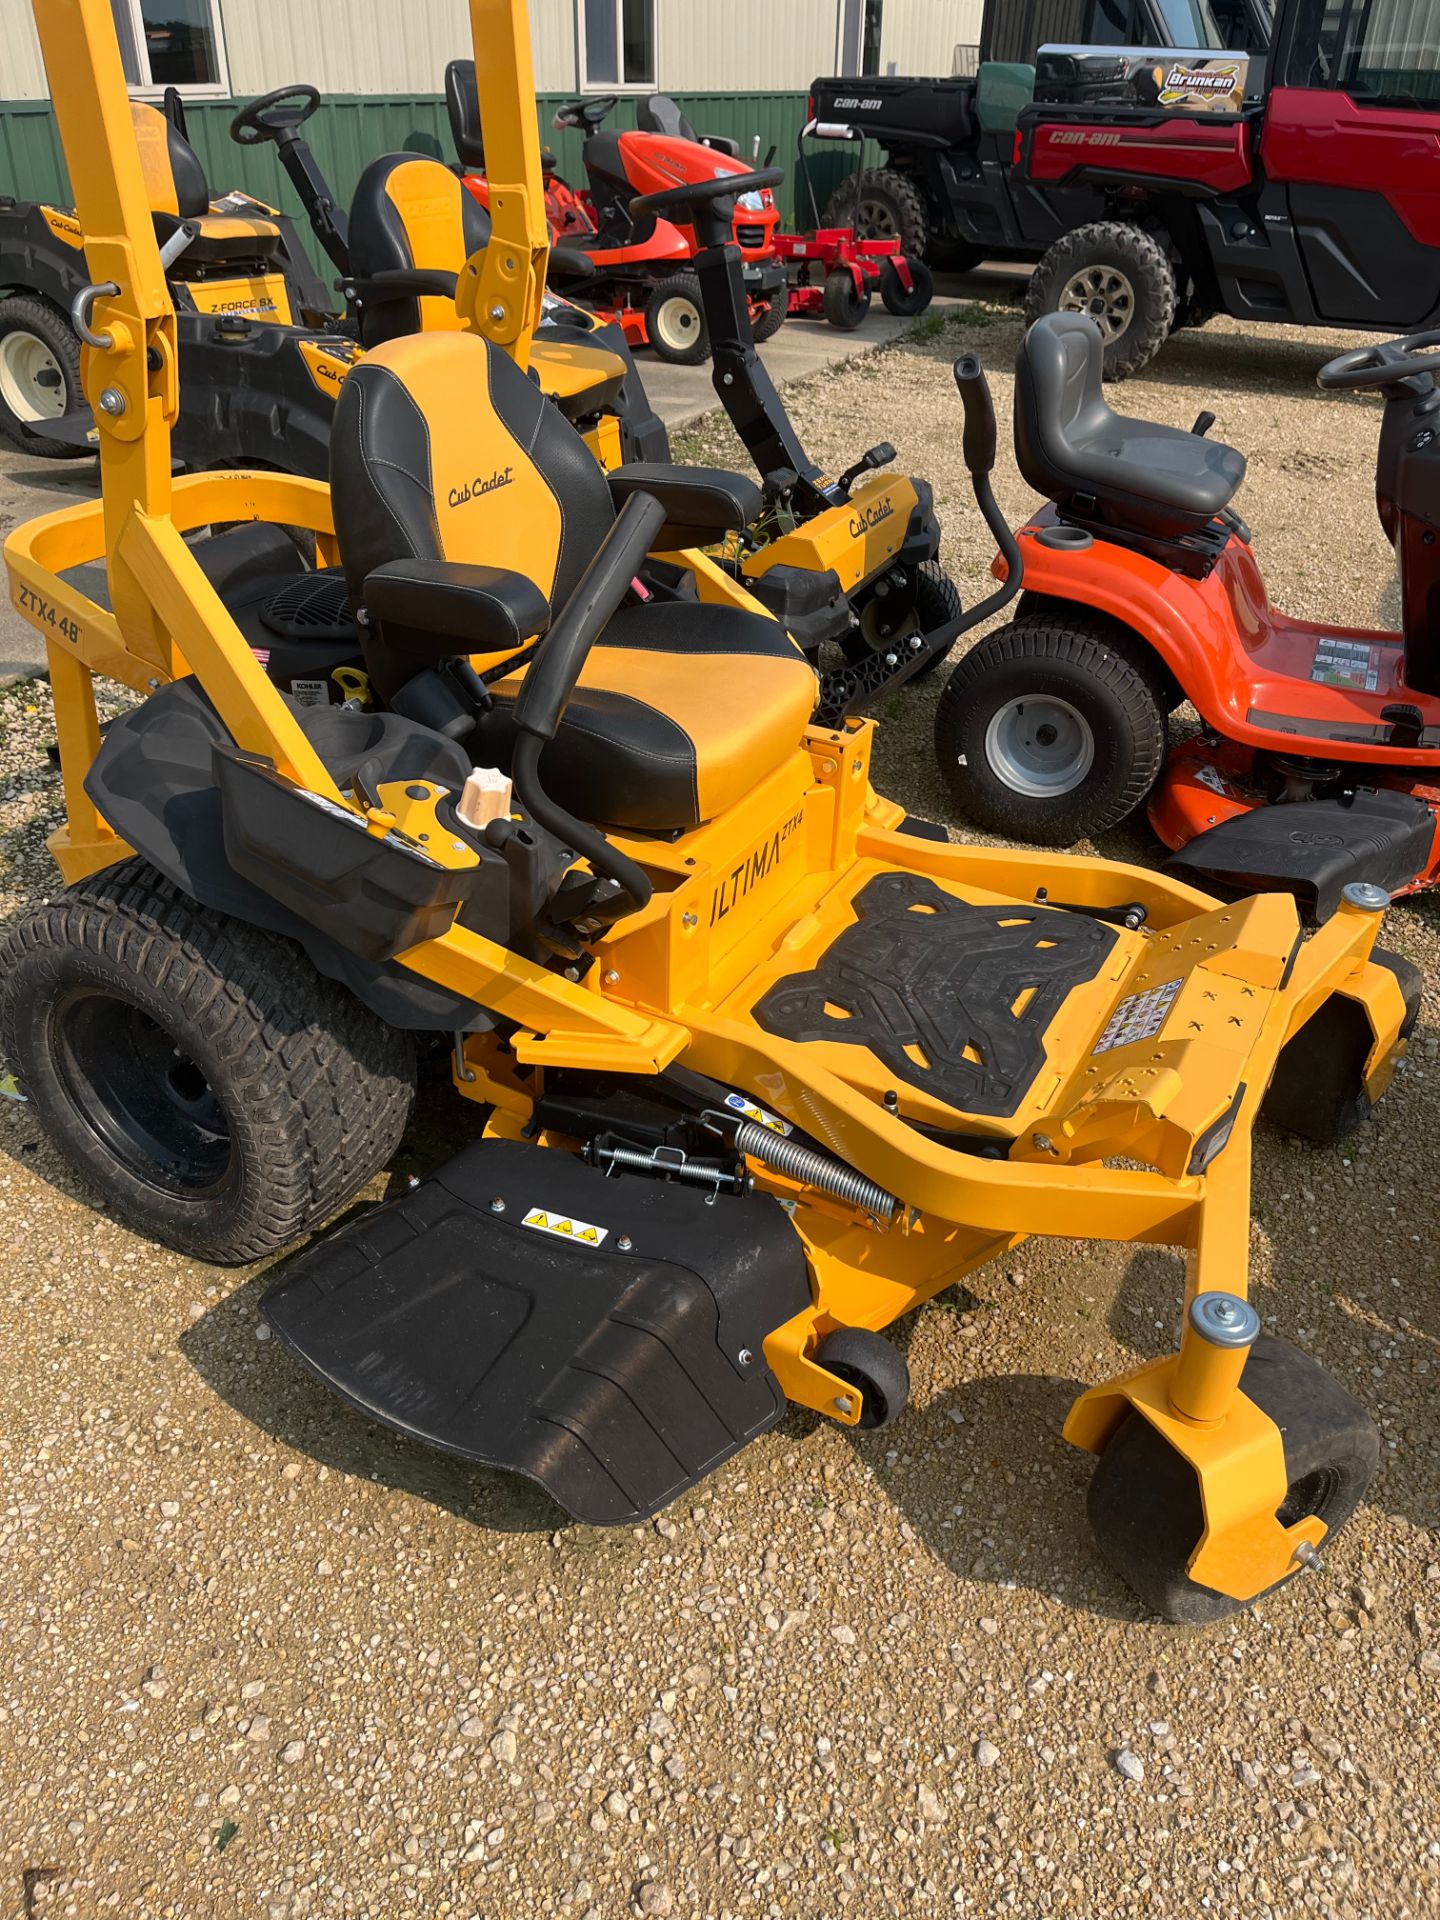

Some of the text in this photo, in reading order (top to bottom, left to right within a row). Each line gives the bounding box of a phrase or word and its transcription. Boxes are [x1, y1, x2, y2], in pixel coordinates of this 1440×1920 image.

[1168, 72, 1234, 88] Brunkan
[316, 364, 337, 381] Cub
[448, 466, 513, 508] Cub Cadet
[849, 497, 894, 539] Cub Cadet
[19, 584, 57, 627] ZTX4
[781, 808, 803, 842] ZTX4
